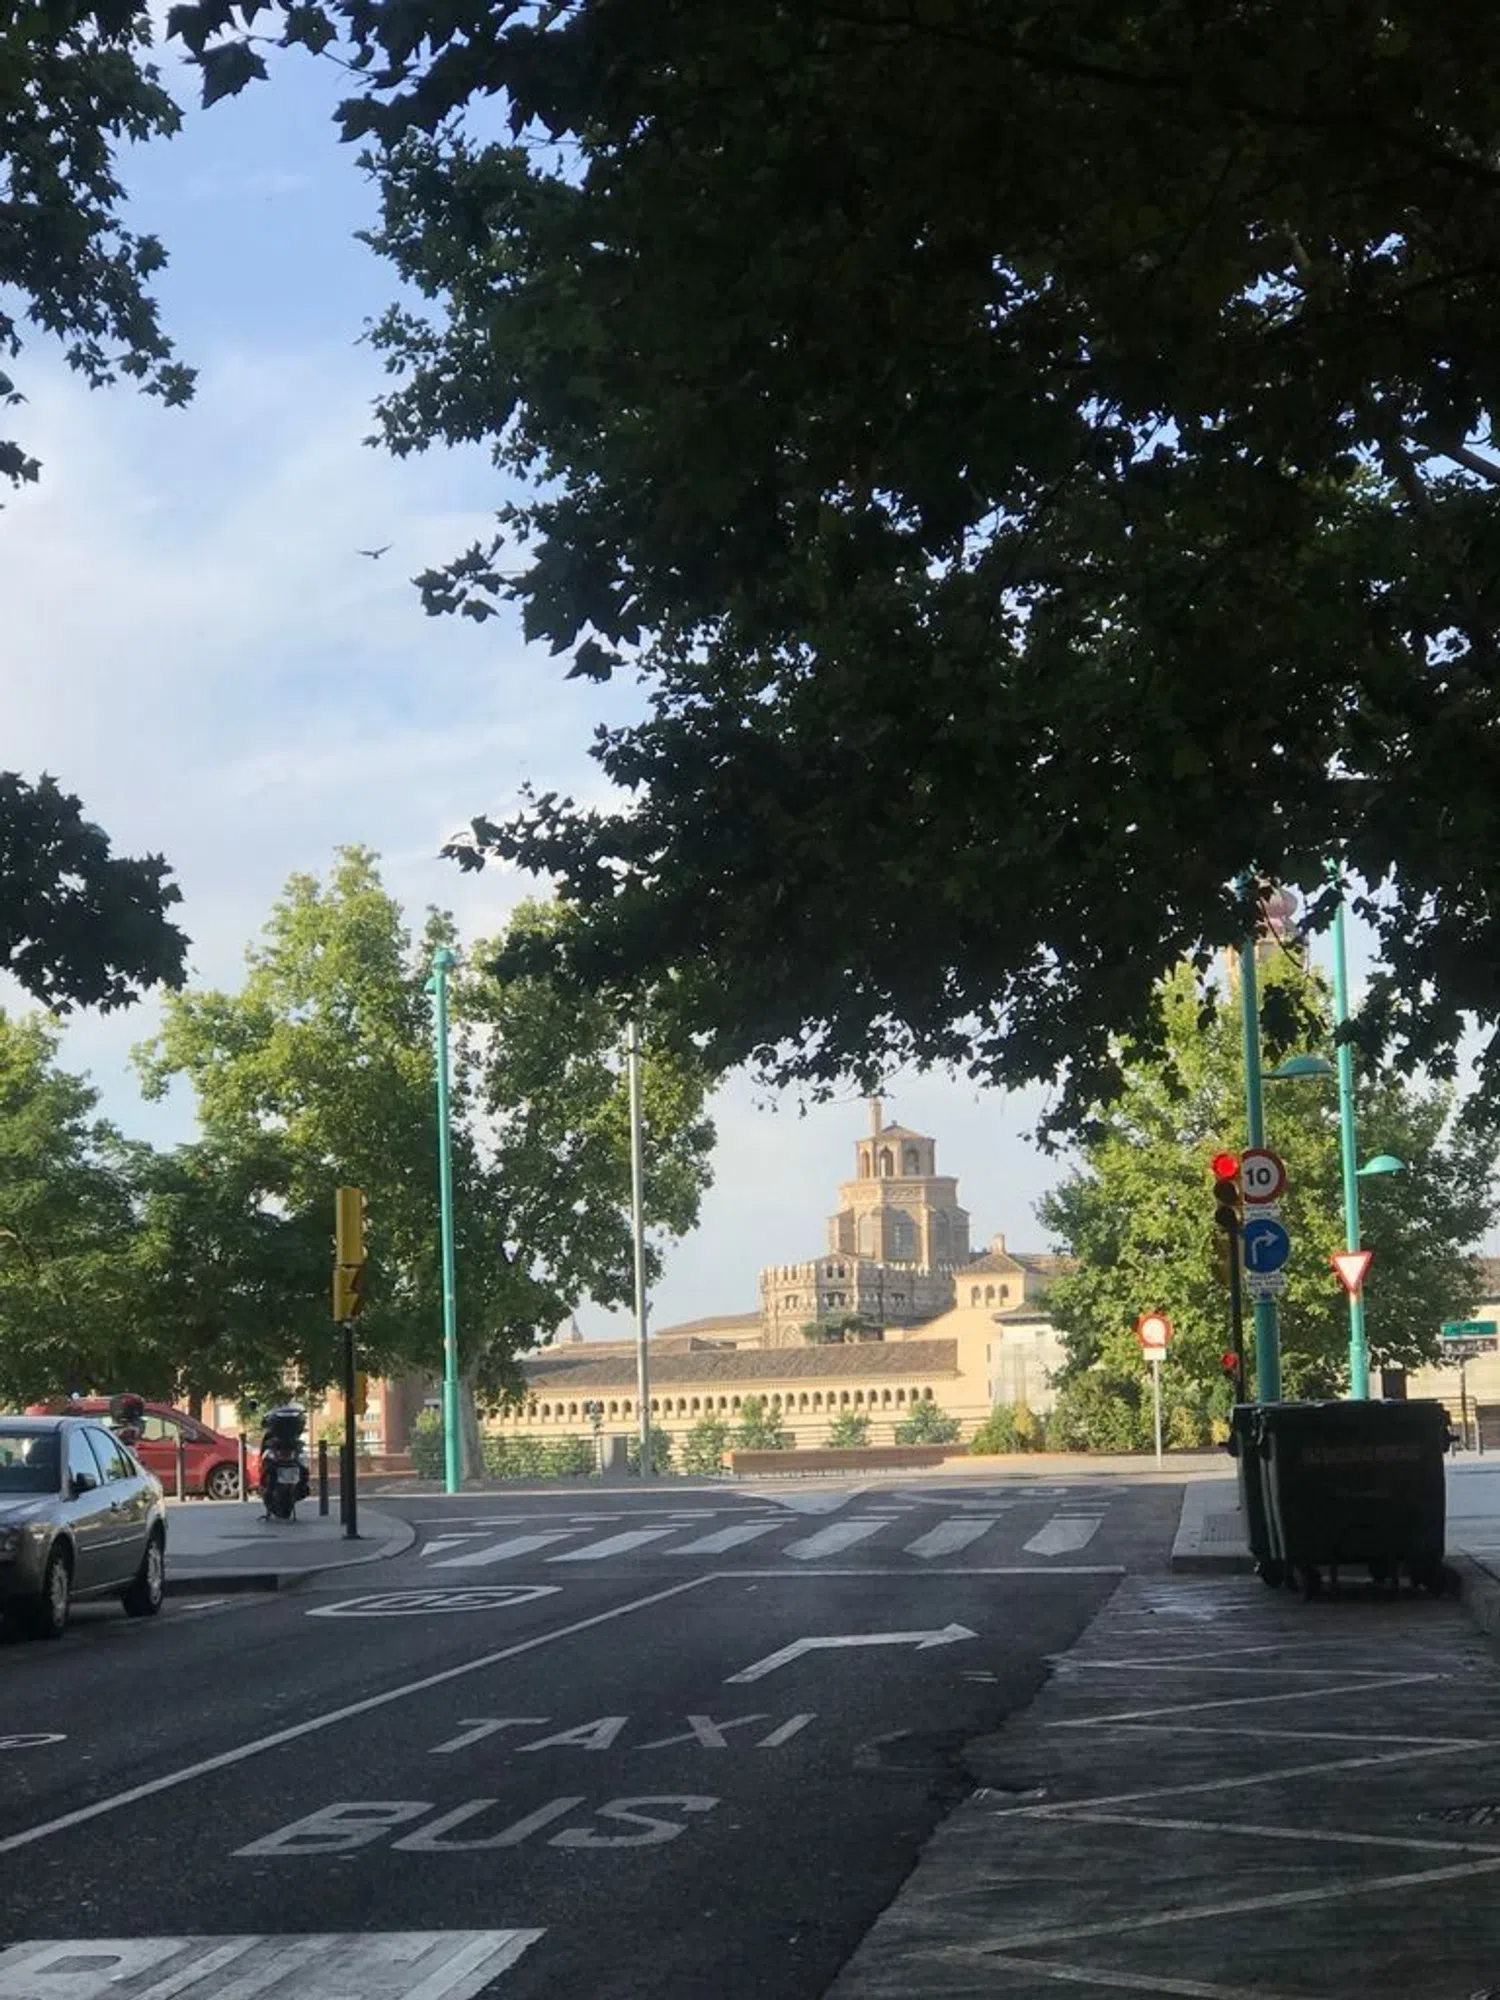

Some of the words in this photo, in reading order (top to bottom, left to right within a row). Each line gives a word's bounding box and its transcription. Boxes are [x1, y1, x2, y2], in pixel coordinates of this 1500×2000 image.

[1245, 1168, 1271, 1186] 10
[428, 1713, 817, 1753] TAXI
[231, 1796, 720, 1857] BUS
